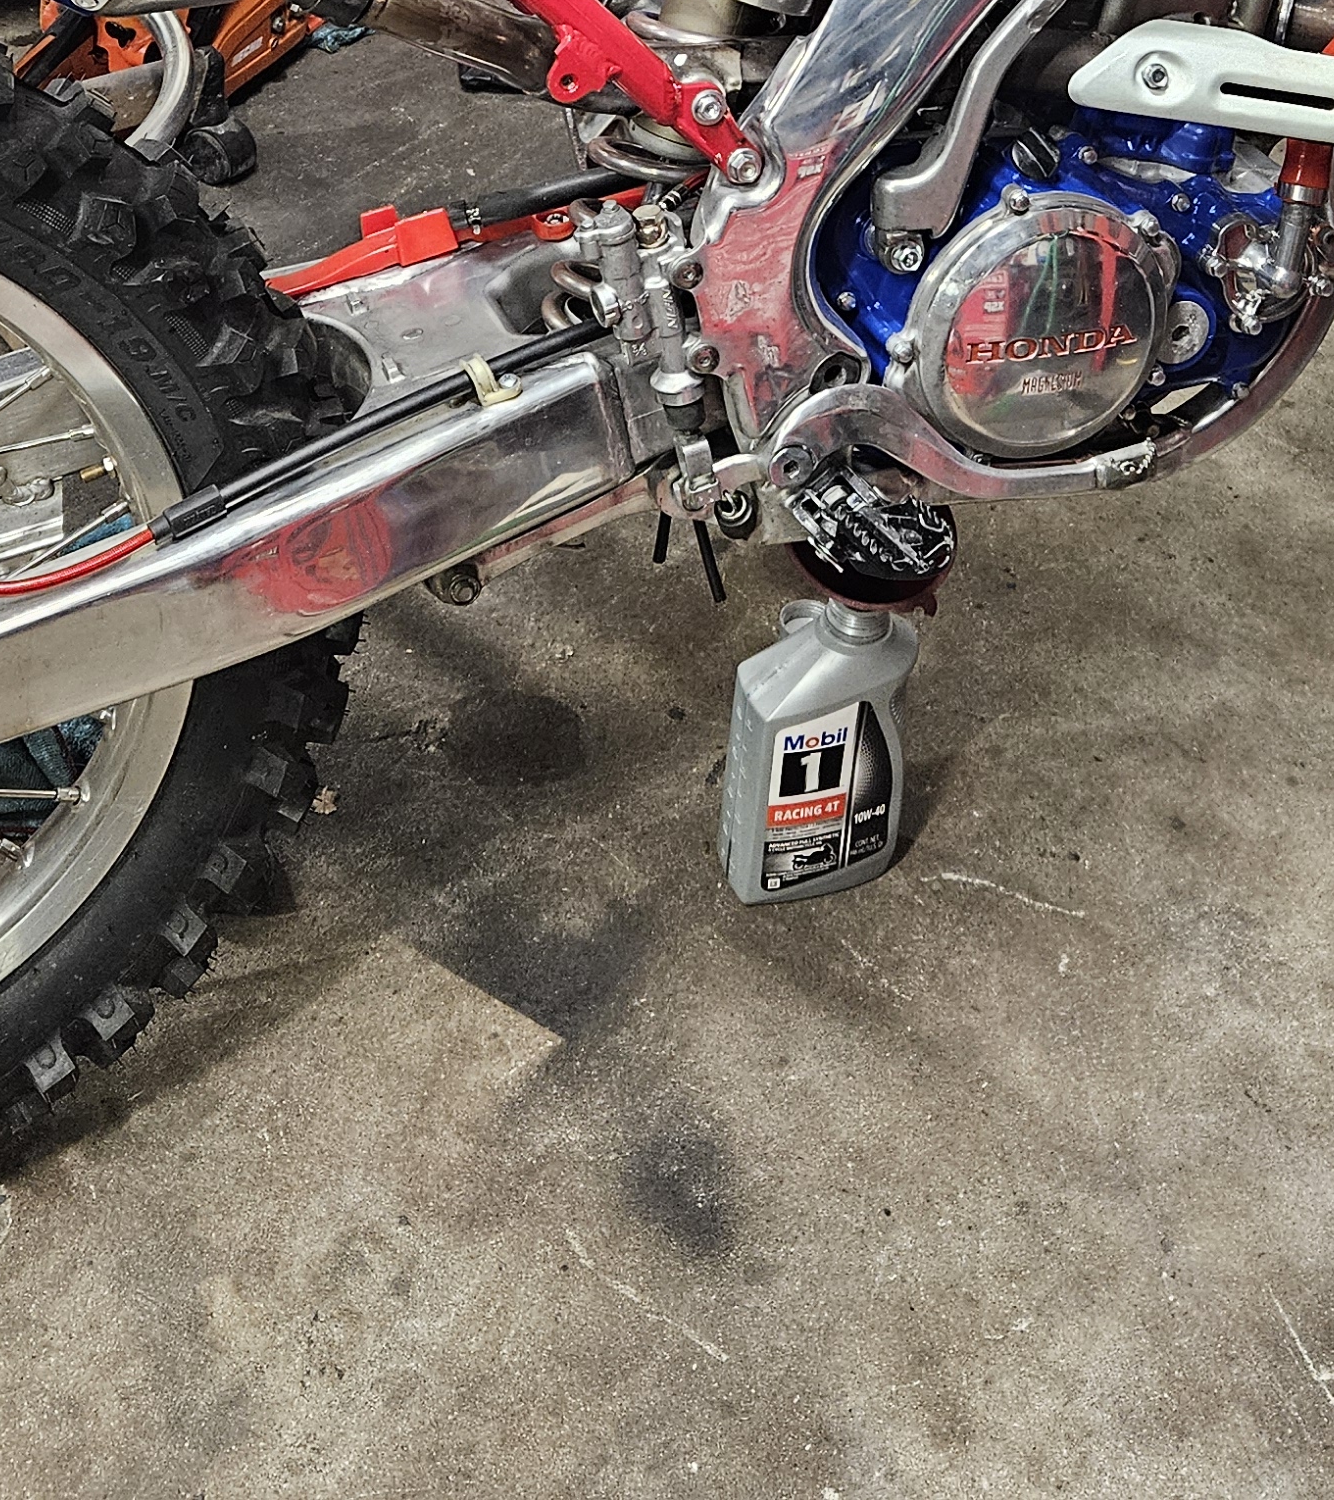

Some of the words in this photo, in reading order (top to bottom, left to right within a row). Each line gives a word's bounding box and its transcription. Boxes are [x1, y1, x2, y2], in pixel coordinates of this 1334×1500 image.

[966, 323, 1138, 366] HONDA
[783, 727, 849, 751] Mobil
[800, 751, 822, 794] 1
[774, 804, 822, 822] RACING
[824, 800, 841, 814] 4T
[854, 803, 886, 825] 10W-40
